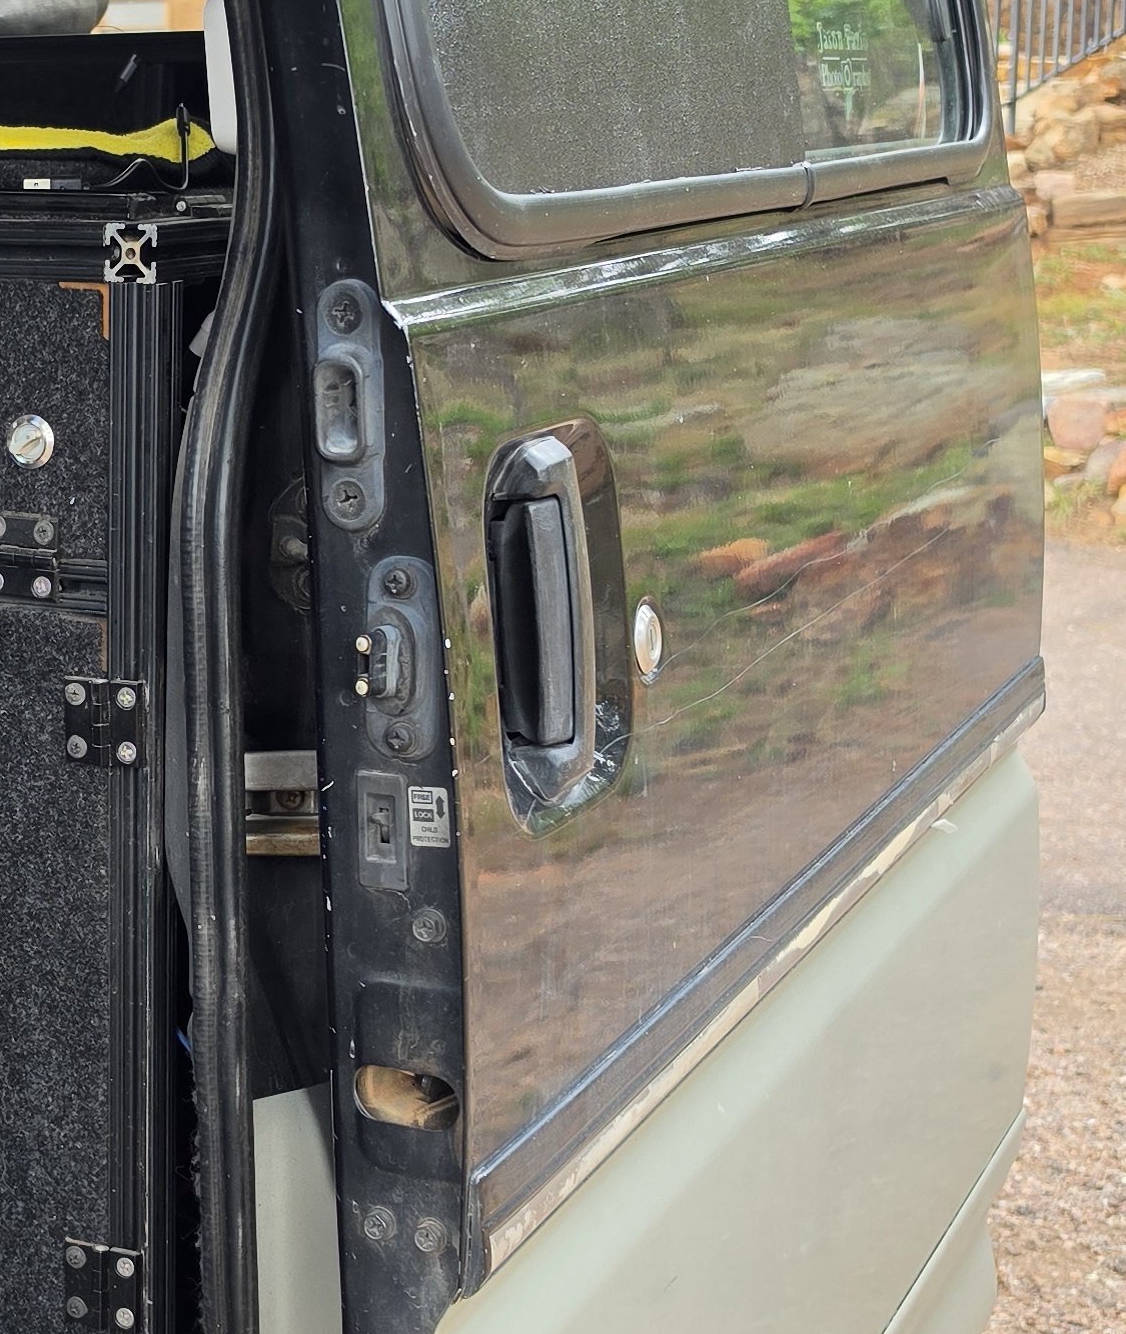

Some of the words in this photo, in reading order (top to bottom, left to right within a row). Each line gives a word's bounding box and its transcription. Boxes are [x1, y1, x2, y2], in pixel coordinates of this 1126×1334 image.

[413, 793, 431, 801] FREE
[414, 811, 433, 819] LOCK
[421, 826, 438, 834] CHILD
[412, 835, 449, 844] PROTECTION
